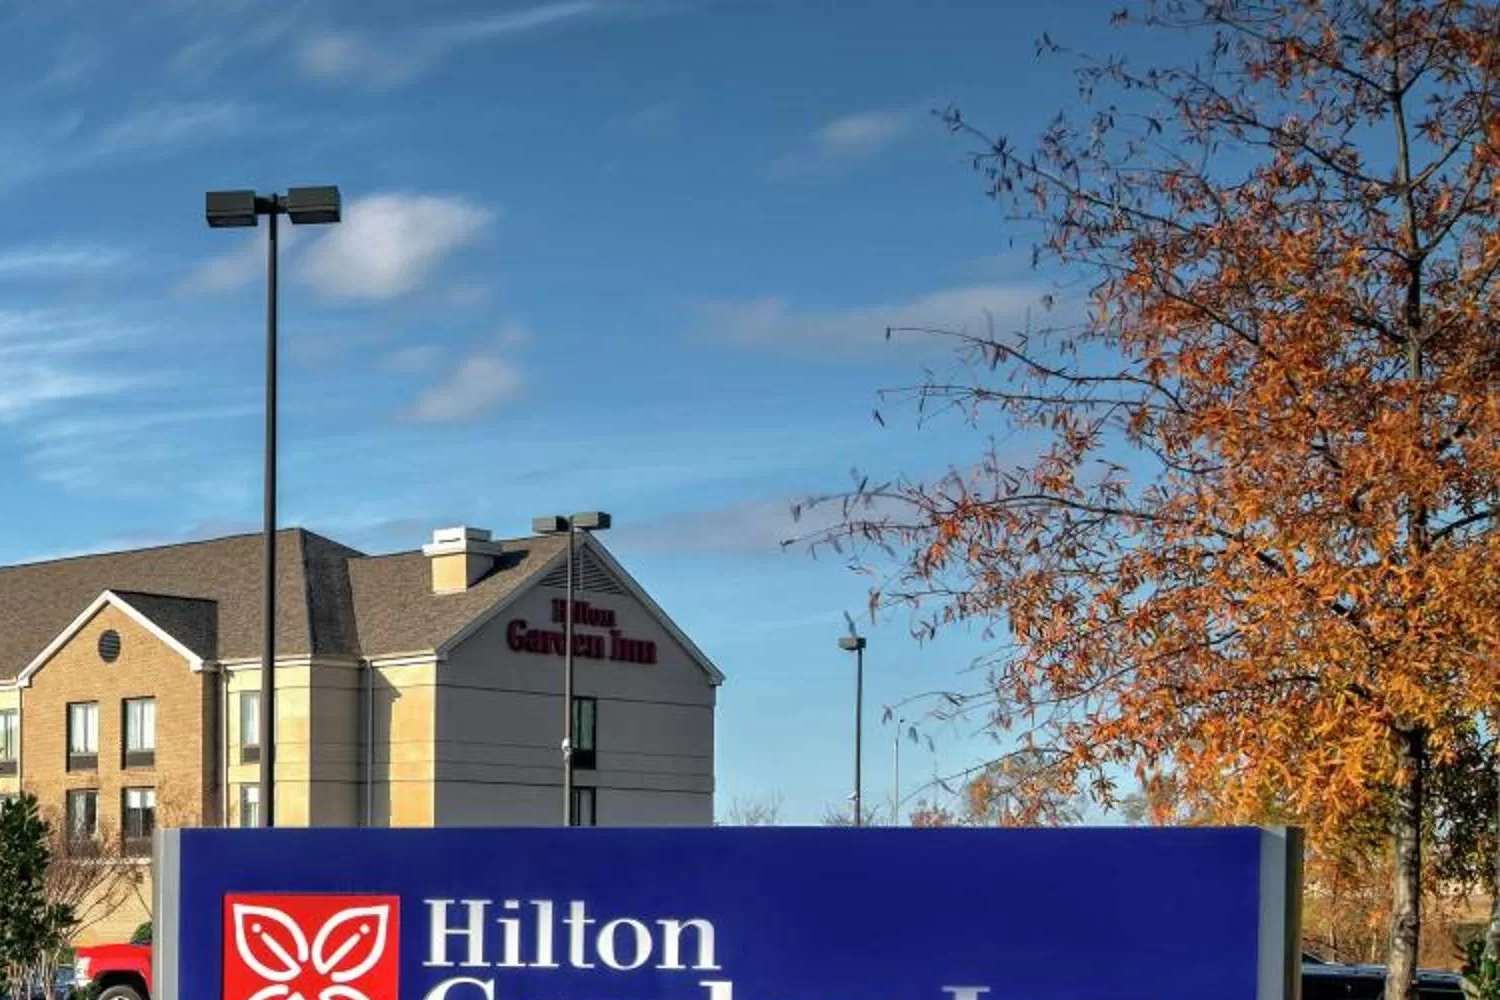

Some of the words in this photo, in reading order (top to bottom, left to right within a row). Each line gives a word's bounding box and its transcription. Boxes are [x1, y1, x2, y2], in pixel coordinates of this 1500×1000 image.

[551, 599, 617, 627] Hlton
[610, 629, 658, 664] Inn
[423, 899, 722, 971] Hilton
